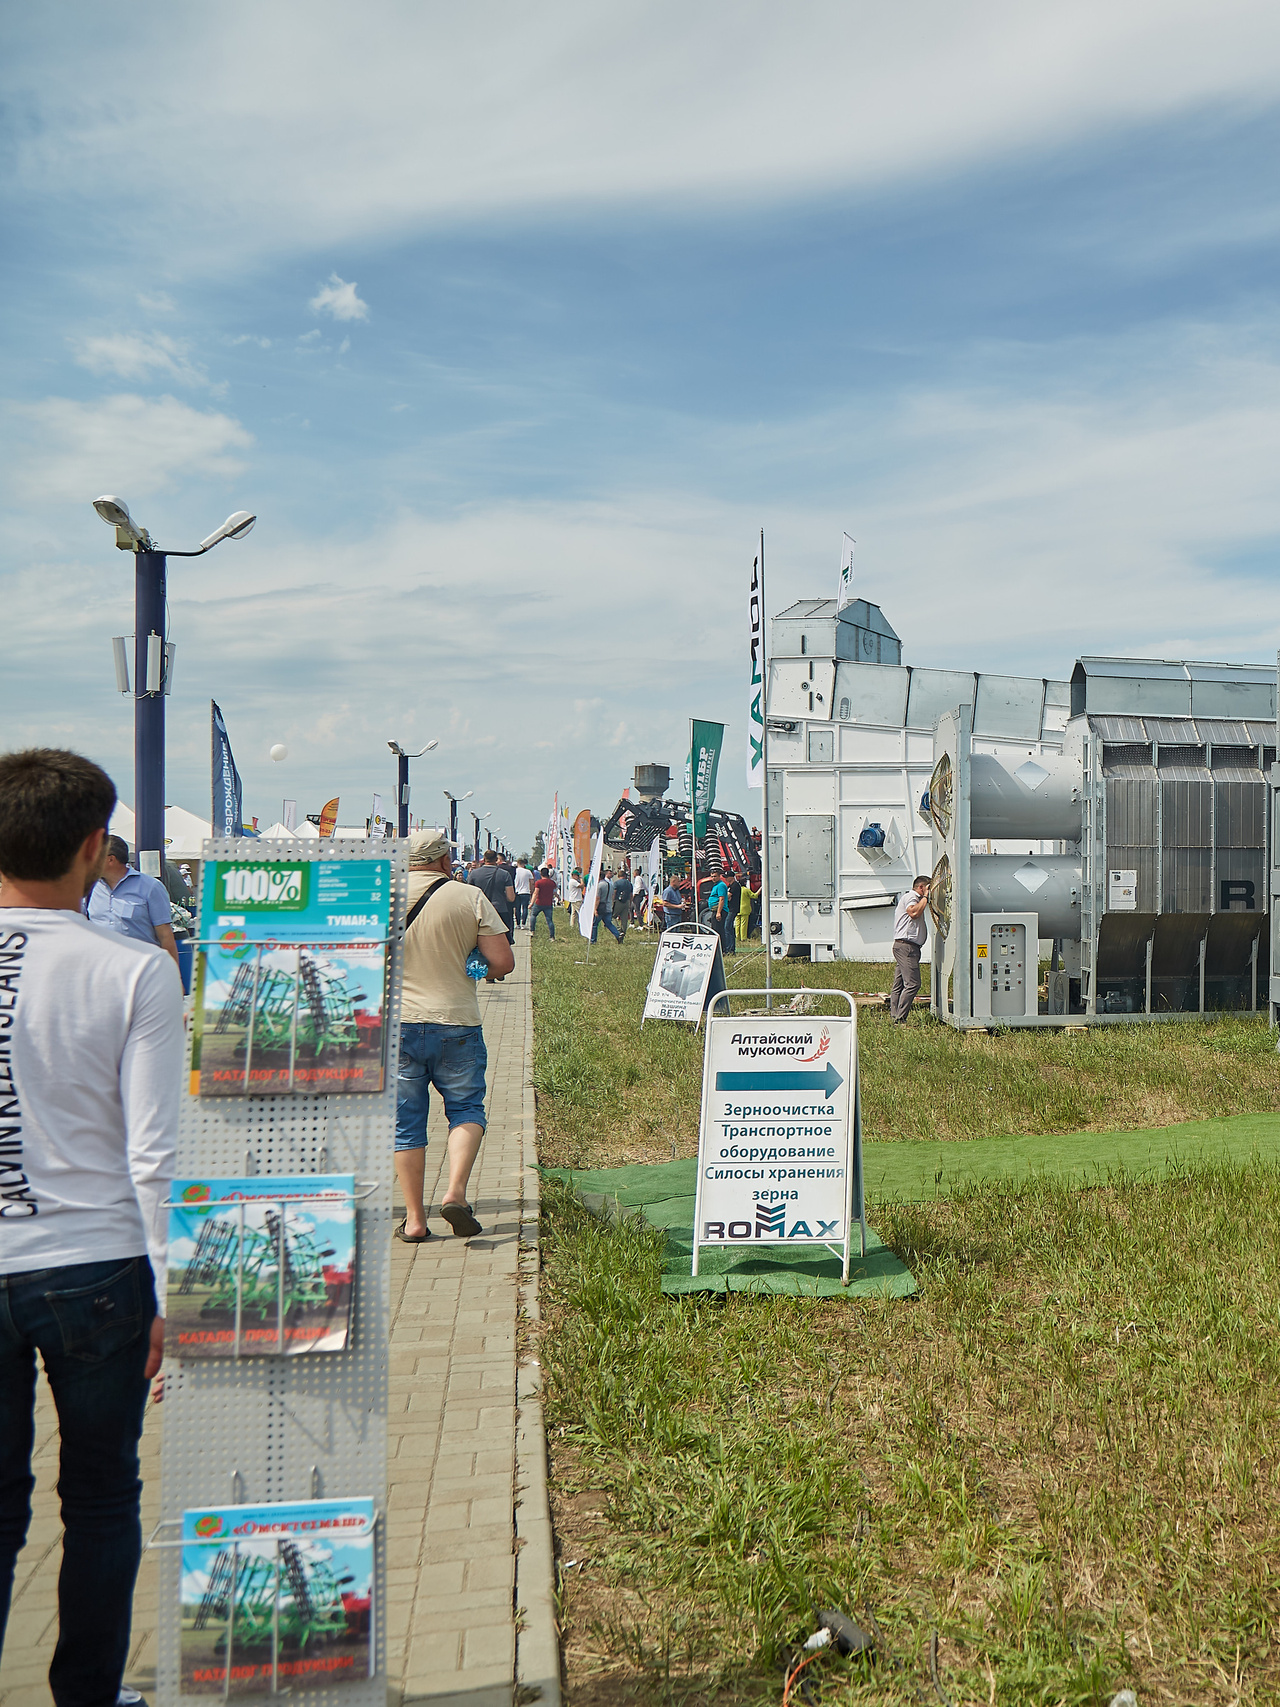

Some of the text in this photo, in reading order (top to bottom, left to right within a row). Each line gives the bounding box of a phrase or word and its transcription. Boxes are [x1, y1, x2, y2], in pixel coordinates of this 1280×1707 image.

[697, 747, 708, 790] ЛБР
[375, 865, 381, 873] 4
[222, 869, 302, 901] 100%
[370, 892, 382, 901] 32
[326, 914, 379, 925] ТУМАН-3
[662, 937, 713, 951] ROMAX
[731, 1032, 813, 1045] Алтайский
[738, 1046, 805, 1058] мукомол
[724, 1102, 835, 1119] Зерноочистка
[721, 1124, 832, 1140] Транспортное
[719, 1144, 835, 1161] оборудование
[0, 1126, 39, 1218] CALVIN
[705, 1166, 844, 1182] Силосы хранения
[752, 1188, 798, 1203] зерна
[703, 1209, 840, 1239] ROMAX
[178, 1330, 243, 1345] КАТАЛО
